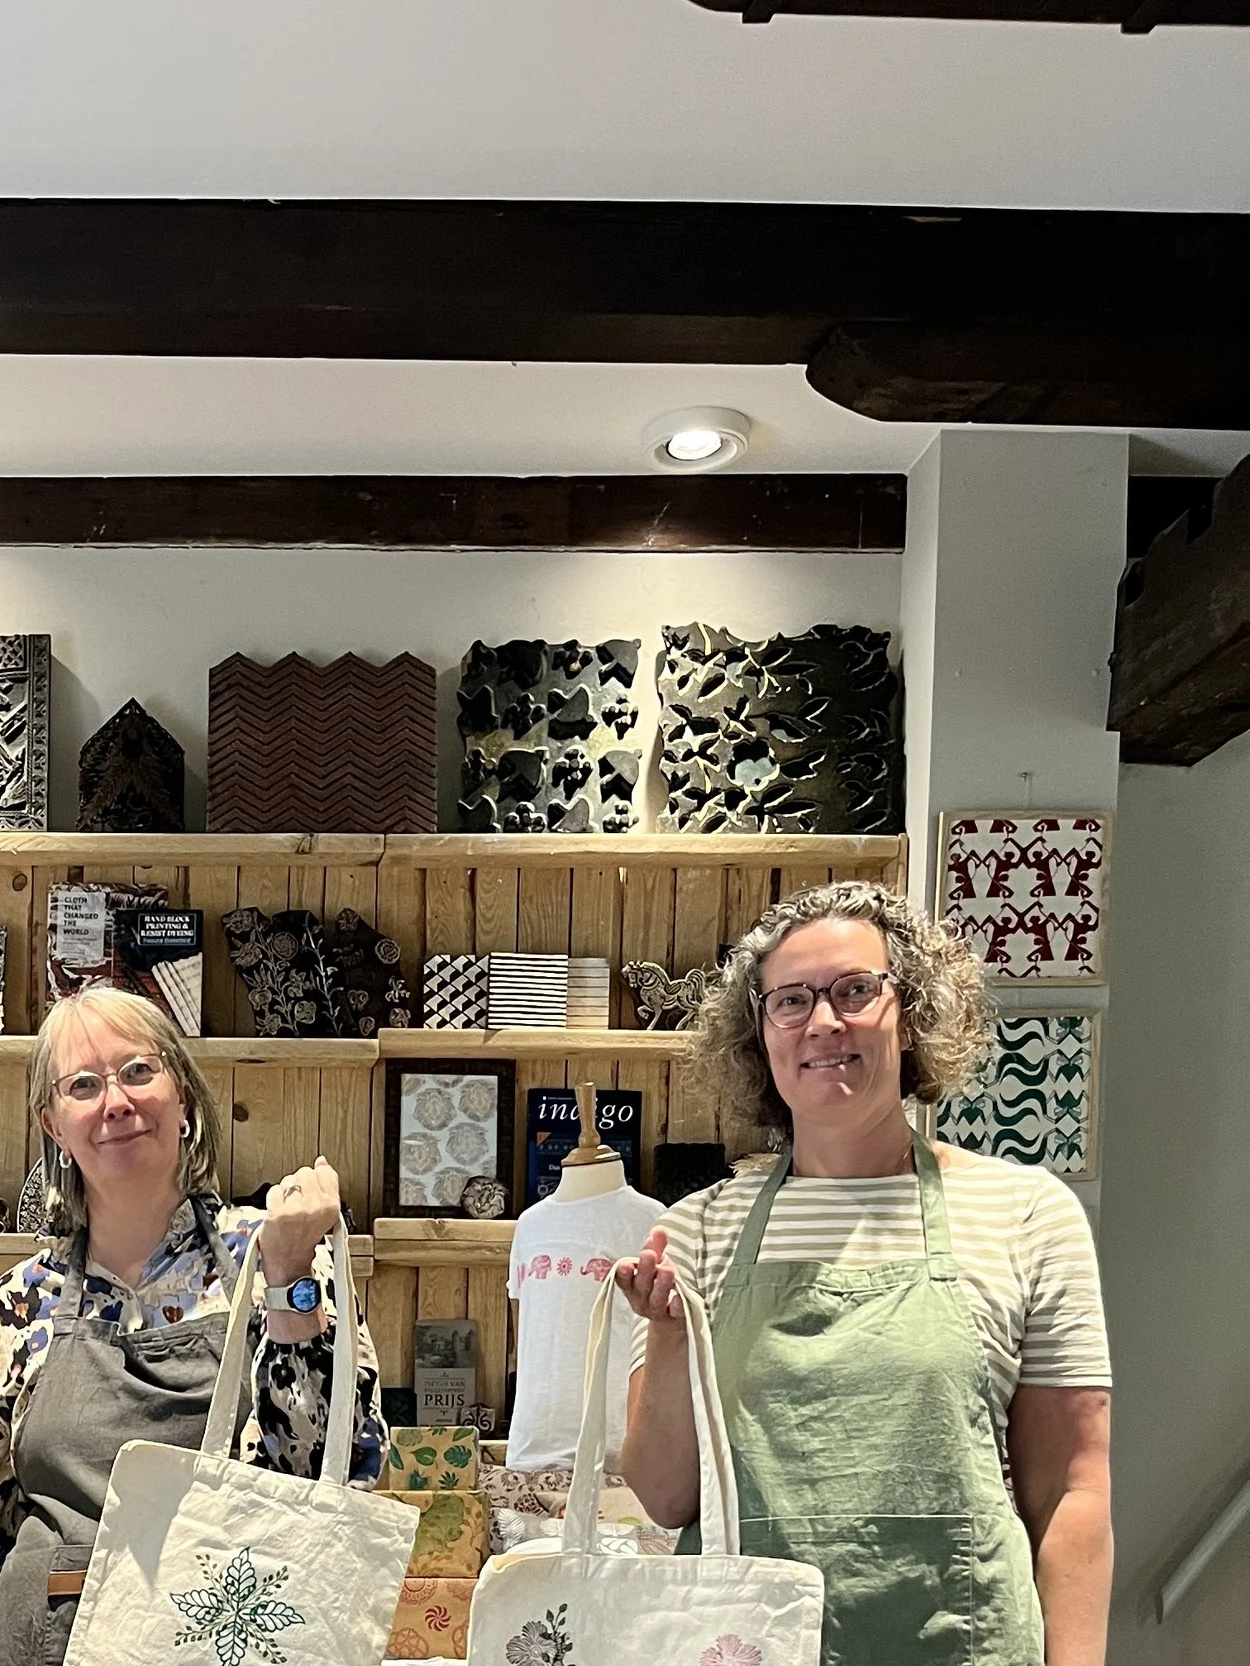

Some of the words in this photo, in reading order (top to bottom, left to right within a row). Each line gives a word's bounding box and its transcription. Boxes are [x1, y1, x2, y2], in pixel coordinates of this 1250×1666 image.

[64, 896, 88, 904] CLOTH
[63, 912, 99, 920] CHANGED
[424, 1394, 465, 1409] PRIJS
